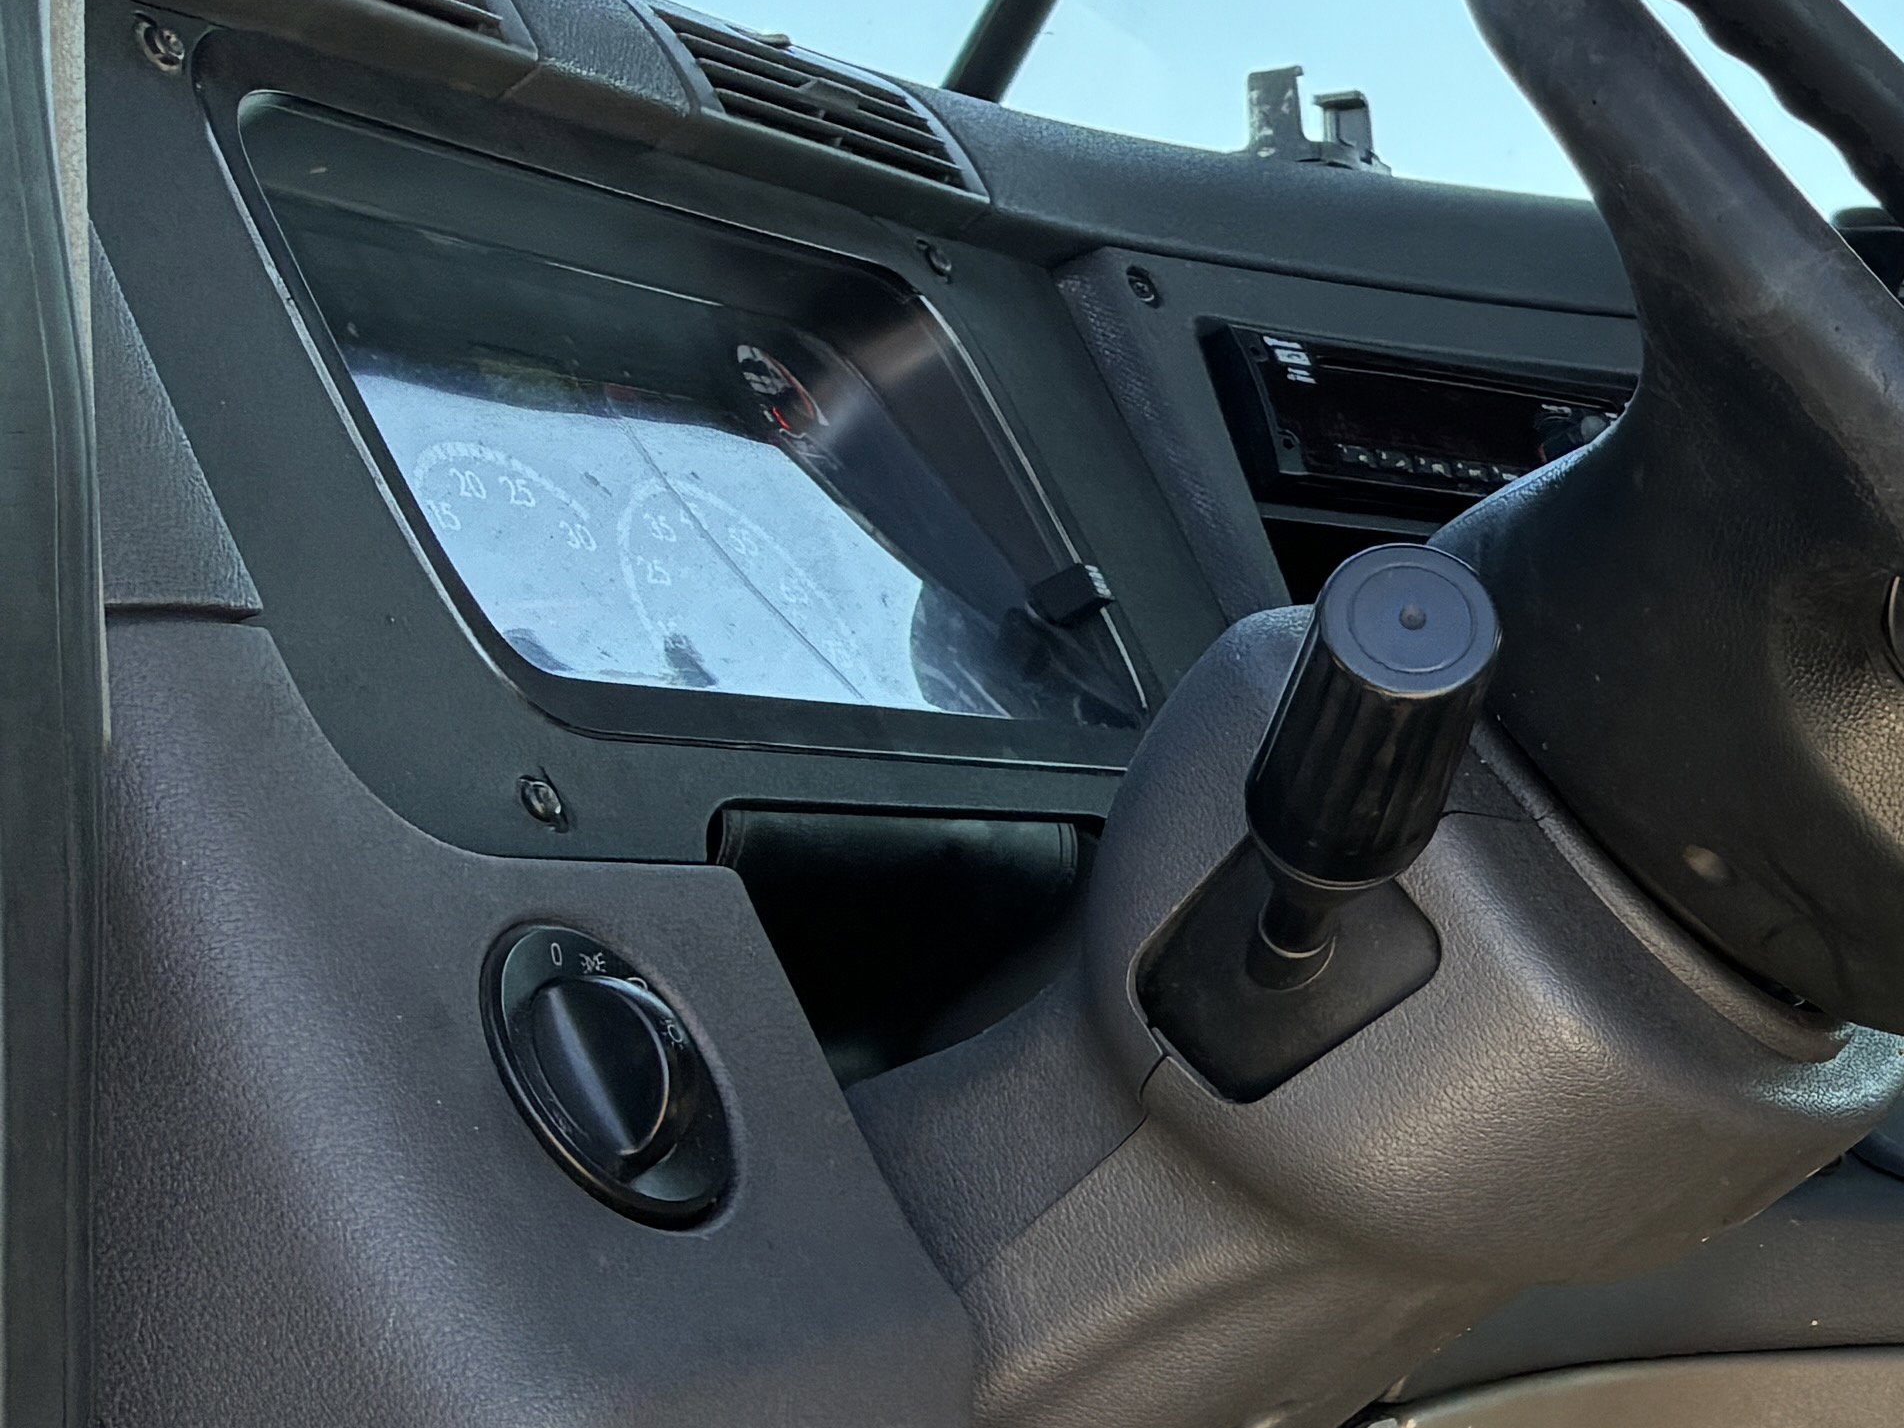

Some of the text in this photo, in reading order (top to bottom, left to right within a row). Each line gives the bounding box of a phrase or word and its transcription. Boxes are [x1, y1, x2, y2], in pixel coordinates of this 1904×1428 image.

[450, 468, 487, 499] 20
[499, 476, 536, 508] 25
[427, 500, 461, 531] 15
[559, 521, 598, 552] 30
